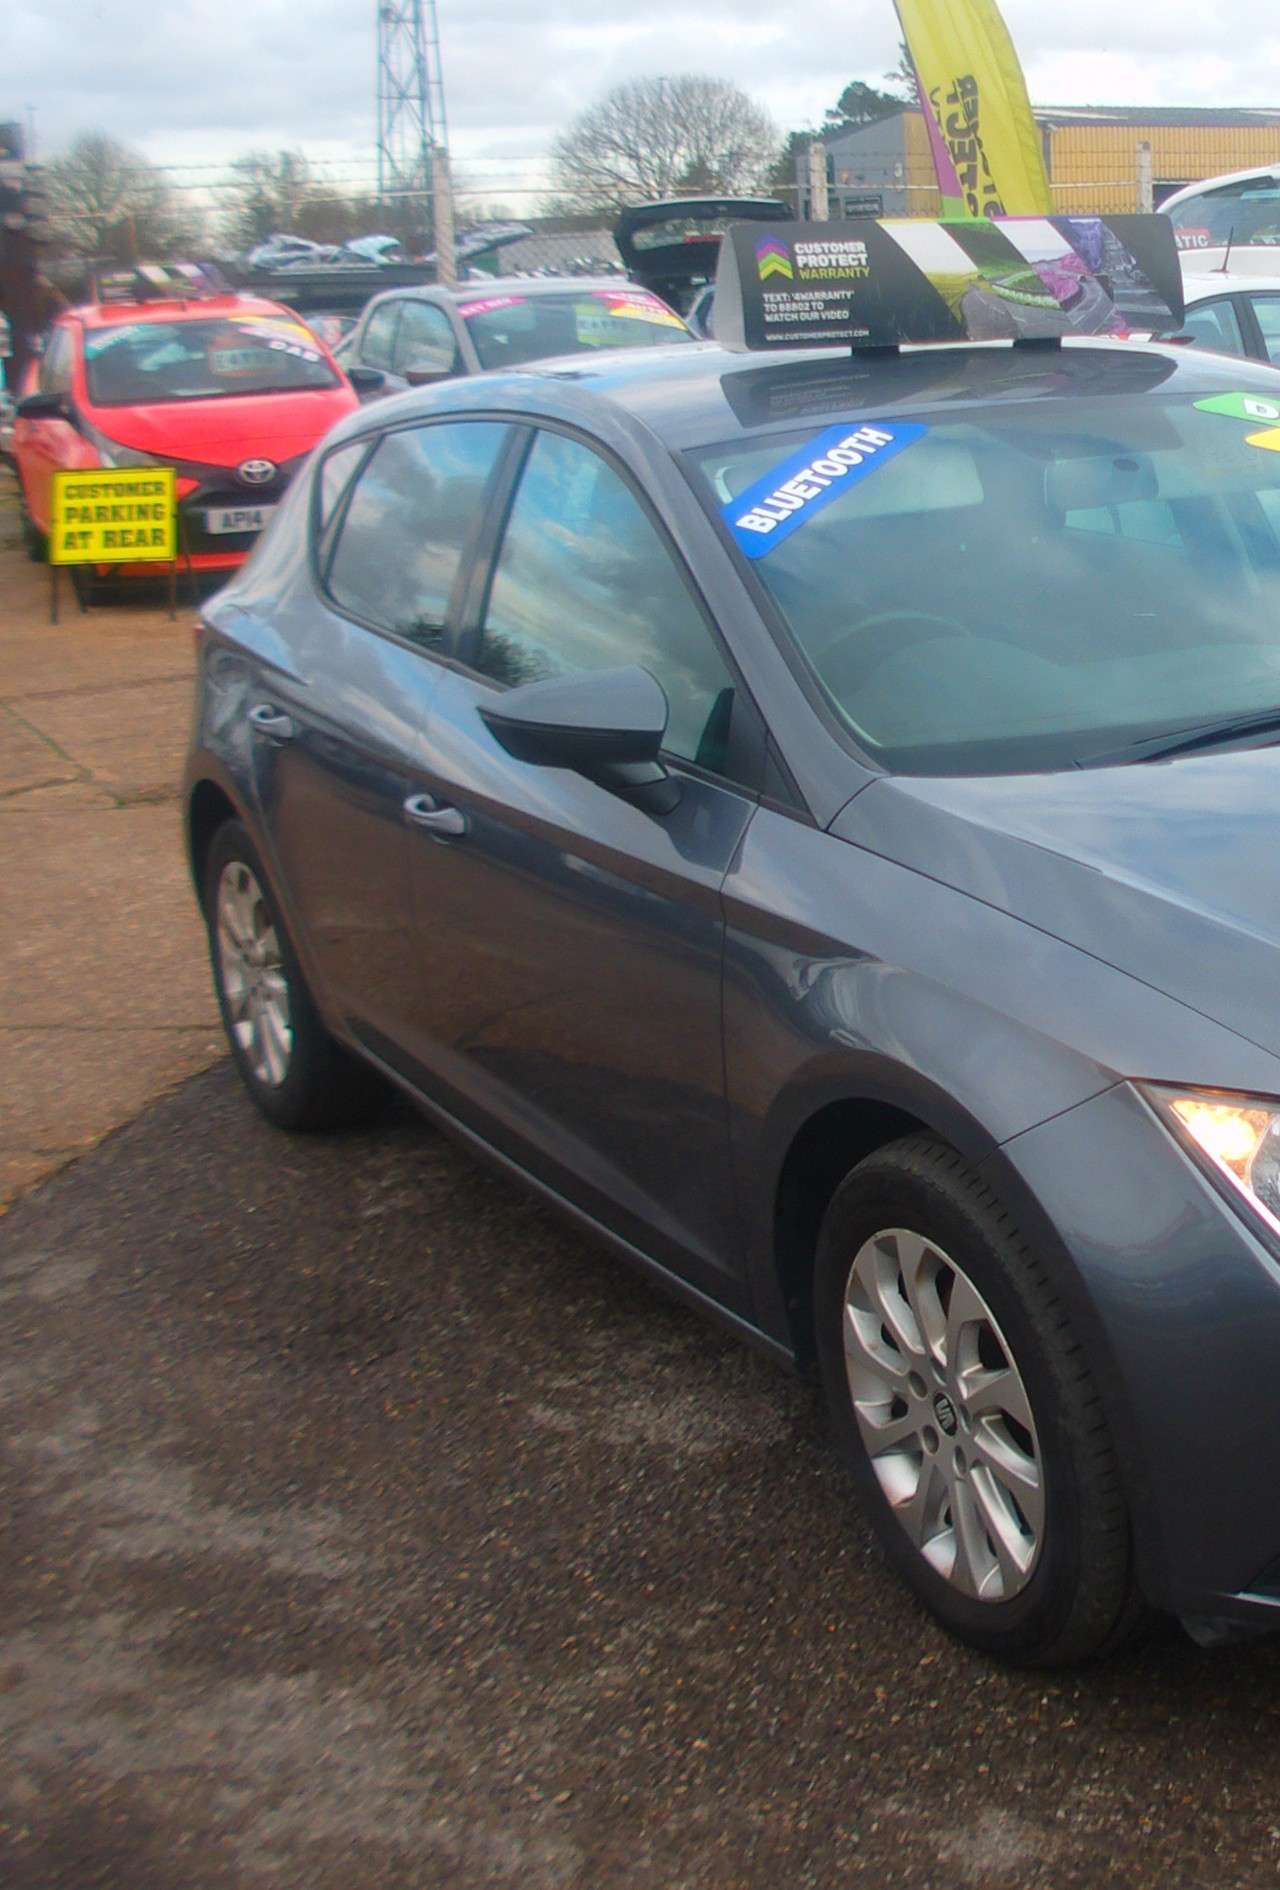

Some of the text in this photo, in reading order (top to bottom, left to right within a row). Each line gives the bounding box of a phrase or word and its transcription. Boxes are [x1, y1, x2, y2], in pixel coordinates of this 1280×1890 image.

[794, 241, 866, 254] CUSTOMER
[796, 254, 868, 267] PROTECT
[799, 267, 870, 280] WARRANTY
[764, 303, 778, 312] TO
[812, 302, 824, 310] TO
[764, 310, 849, 322] WATCH OUR VIDEO
[735, 426, 895, 534] BLUETOOTH
[63, 481, 165, 500] CUSTOMER
[63, 503, 165, 524] PARKING
[63, 528, 165, 549] AT REAR
